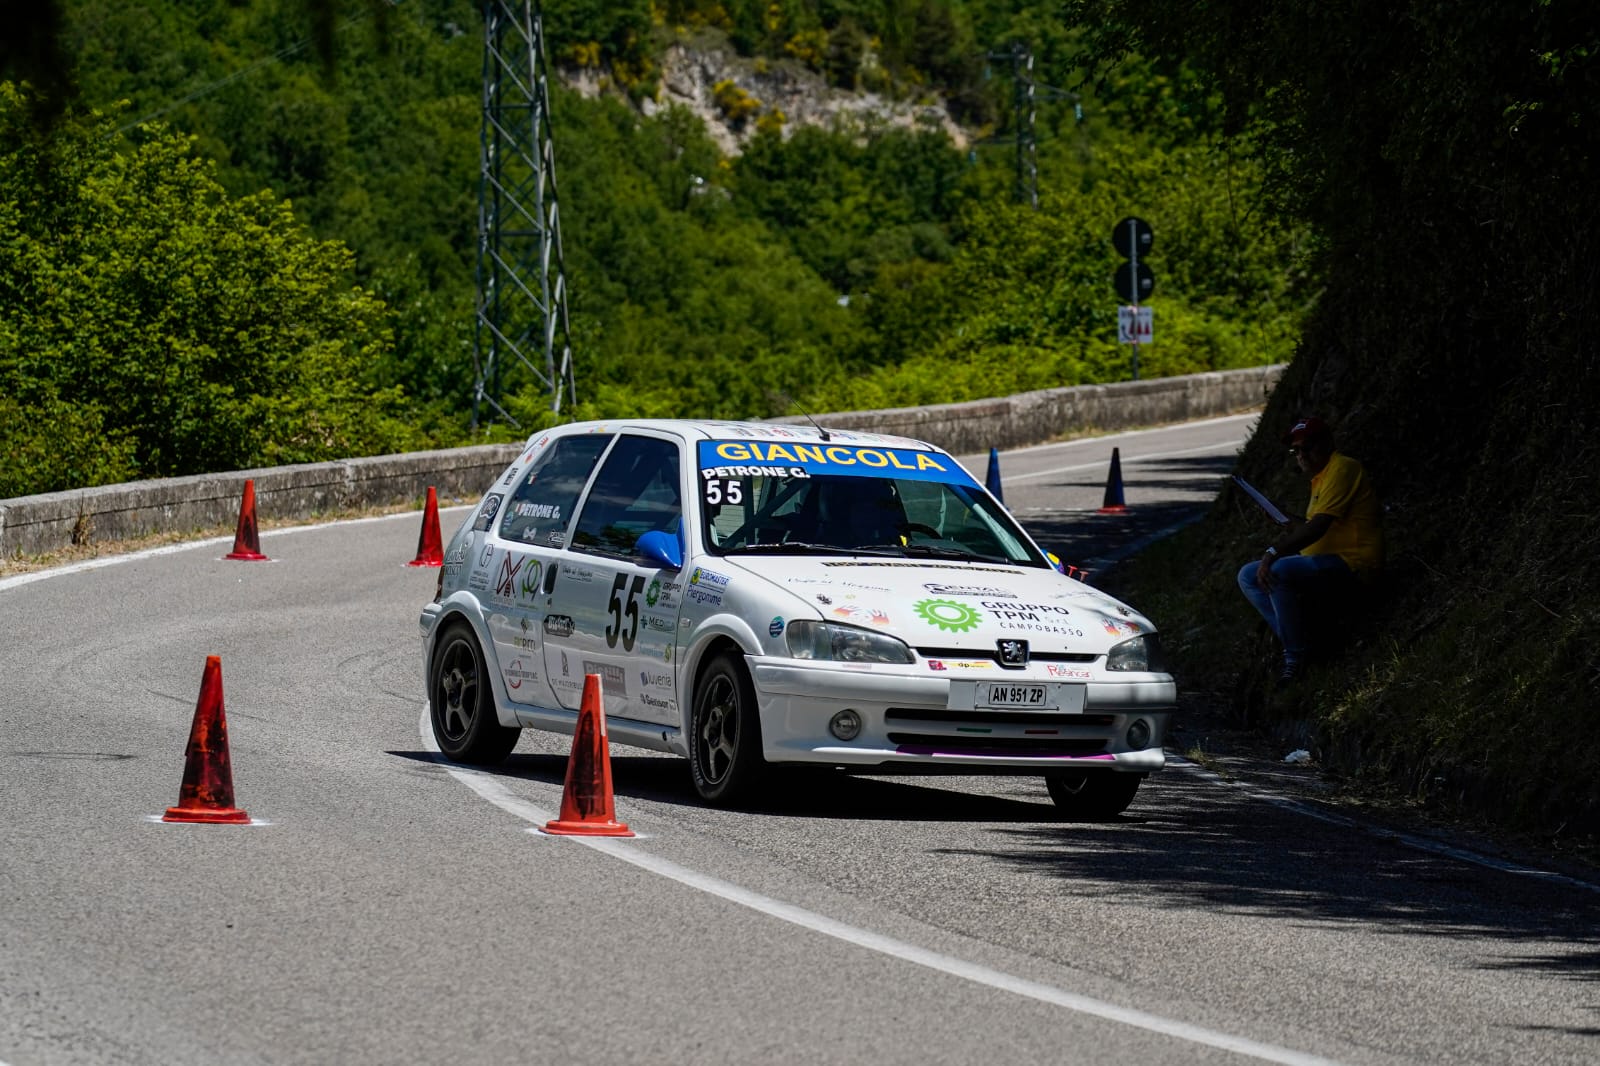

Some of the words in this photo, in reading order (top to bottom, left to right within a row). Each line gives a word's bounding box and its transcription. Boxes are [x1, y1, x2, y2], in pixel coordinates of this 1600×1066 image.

[716, 442, 948, 472] GIANCOLA
[701, 465, 788, 480] PETRONE
[789, 467, 811, 479] G.
[706, 480, 743, 505] 55
[518, 503, 552, 519] PETRONE
[606, 572, 646, 652] 55
[980, 601, 1070, 615] GRUPPO
[987, 610, 1041, 622] TPM
[1000, 622, 1084, 637] CAMPOBASSO
[992, 687, 1008, 702] AN
[1010, 686, 1027, 703] 951
[1029, 688, 1043, 703] ZP
